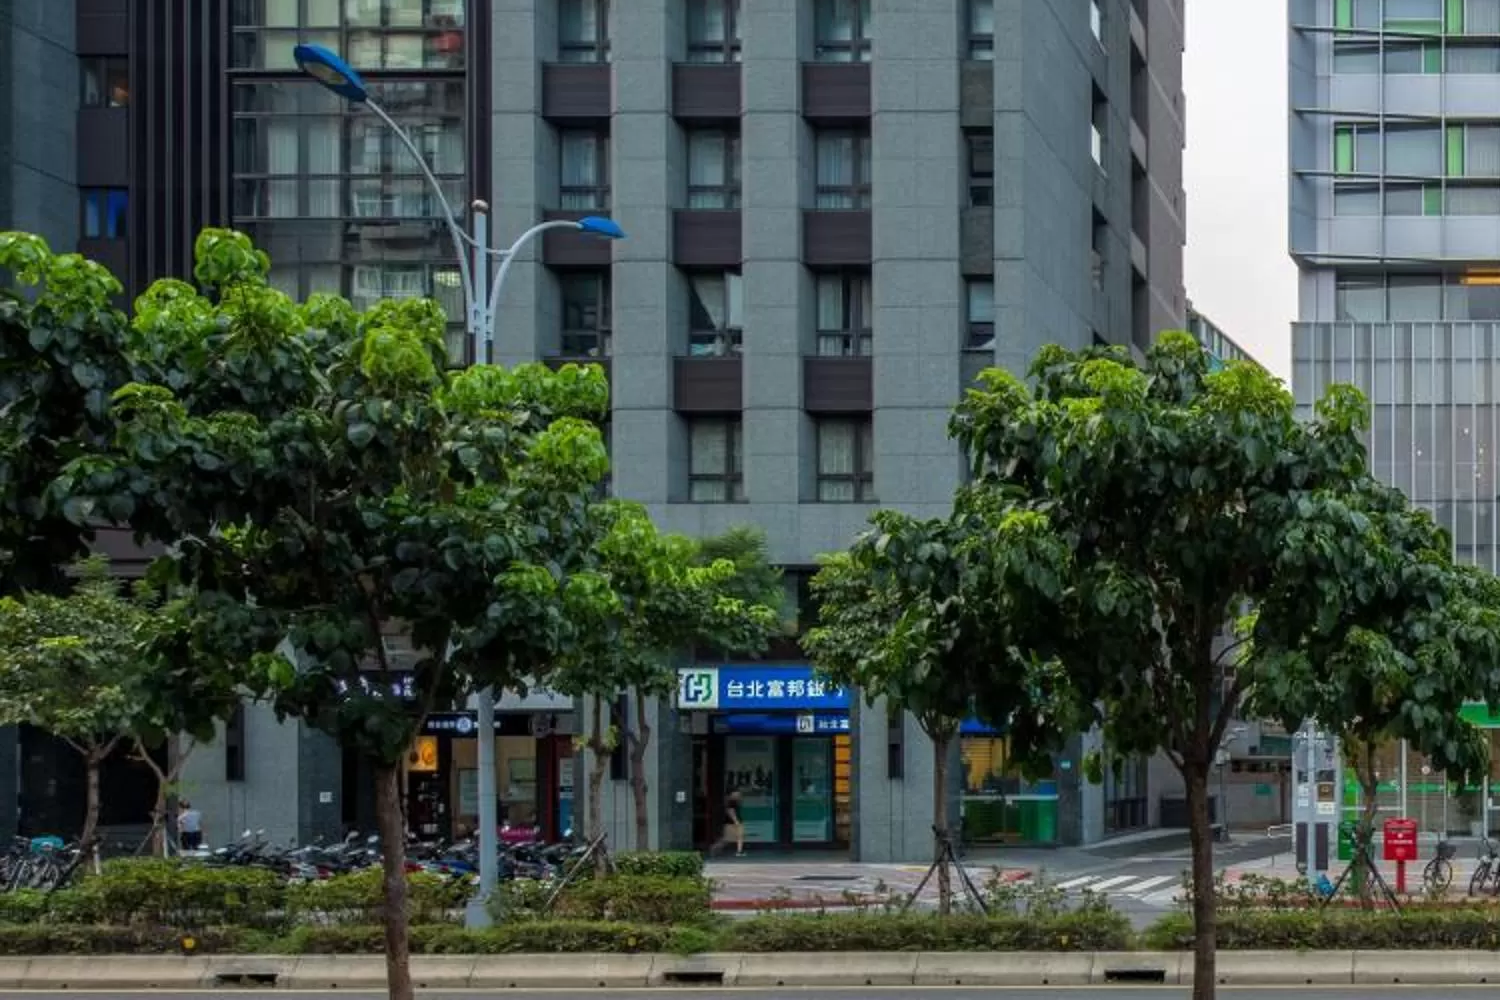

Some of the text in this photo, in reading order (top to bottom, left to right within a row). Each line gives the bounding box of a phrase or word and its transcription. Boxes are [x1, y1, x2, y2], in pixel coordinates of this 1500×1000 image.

[727, 679, 844, 698] 台北富邦銀
